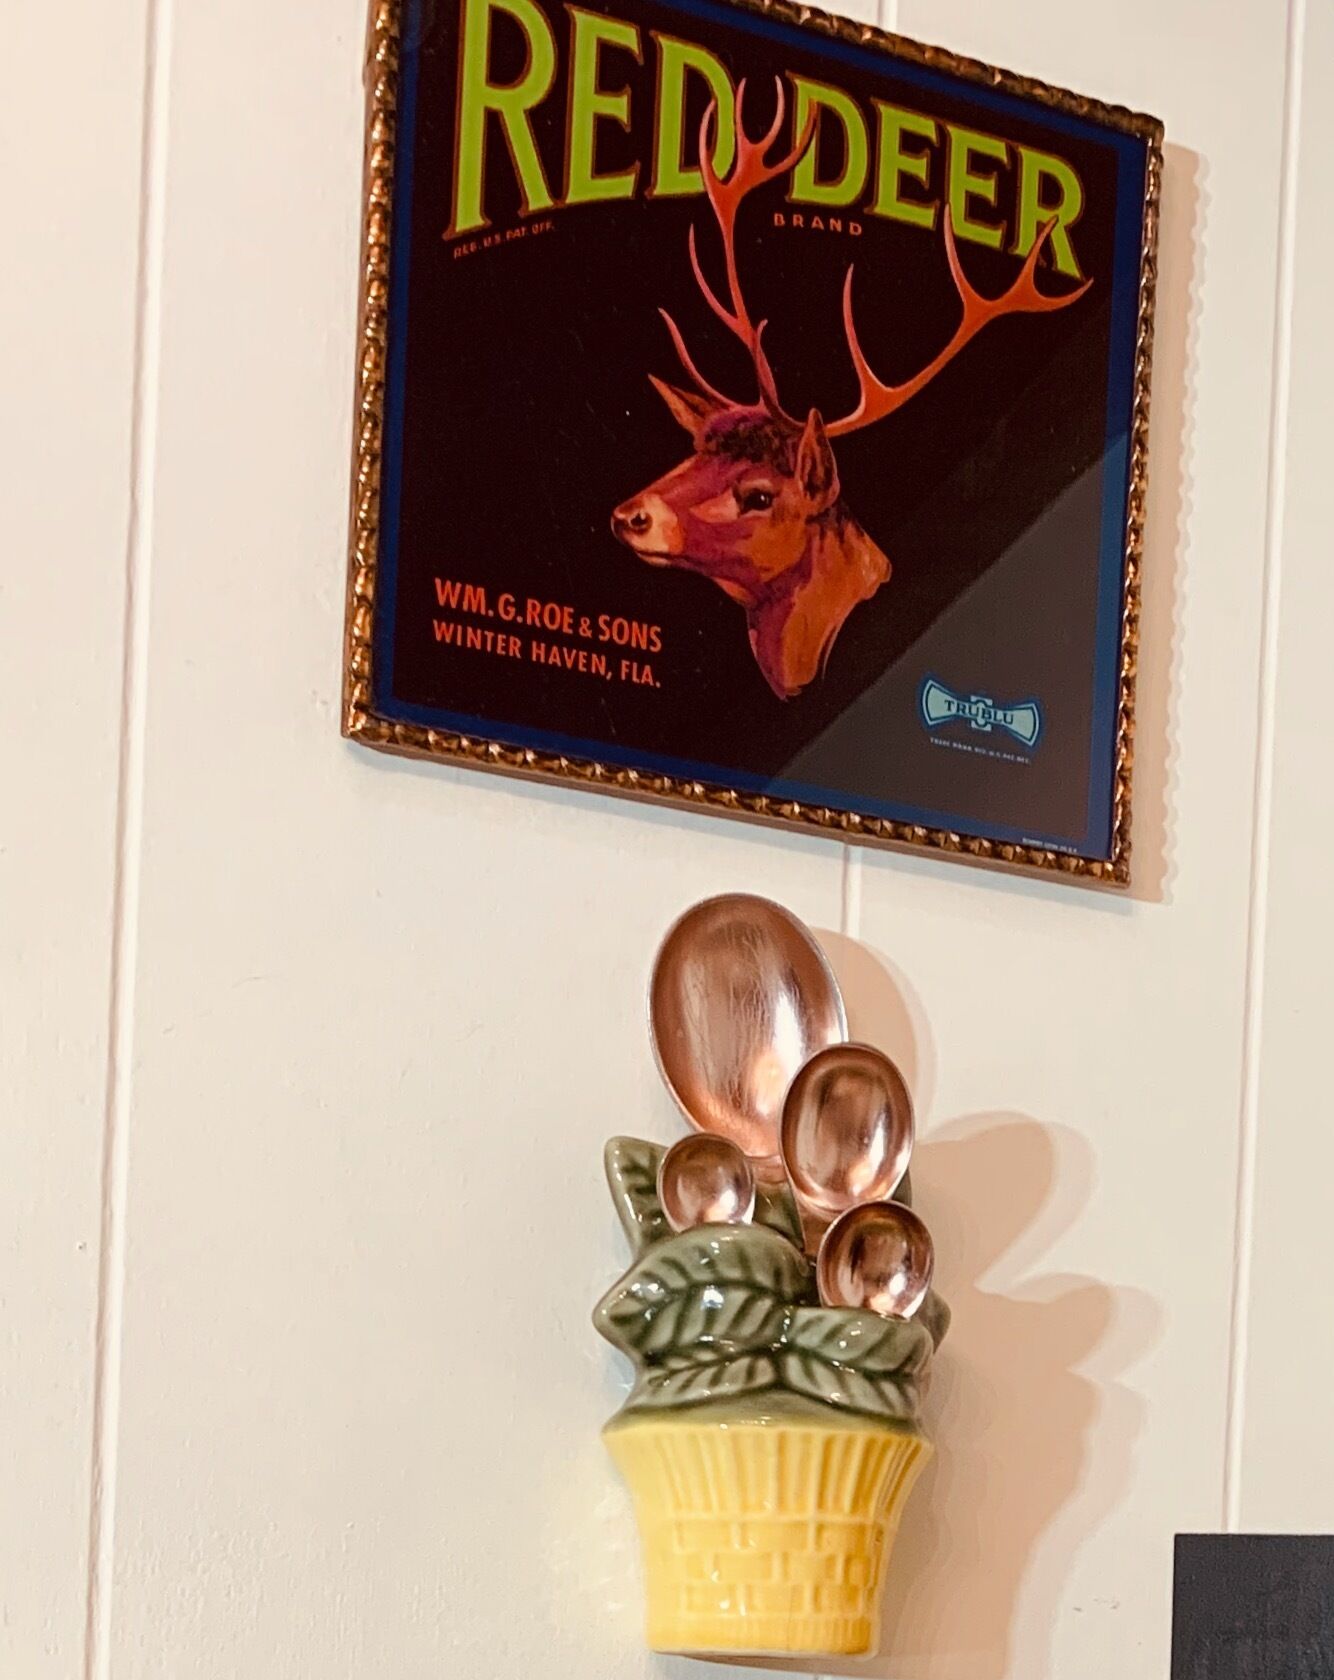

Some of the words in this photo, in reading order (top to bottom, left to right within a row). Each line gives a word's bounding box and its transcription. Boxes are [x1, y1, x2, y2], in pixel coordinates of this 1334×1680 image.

[444, 0, 738, 240] RED
[785, 70, 1086, 281] DEER
[774, 212, 862, 236] BRAND
[432, 618, 522, 659] WINTER
[531, 640, 613, 681] HAVEN,
[620, 659, 661, 688] FLA.
[598, 614, 662, 653] SONS
[944, 699, 1014, 725] TRUBLU
